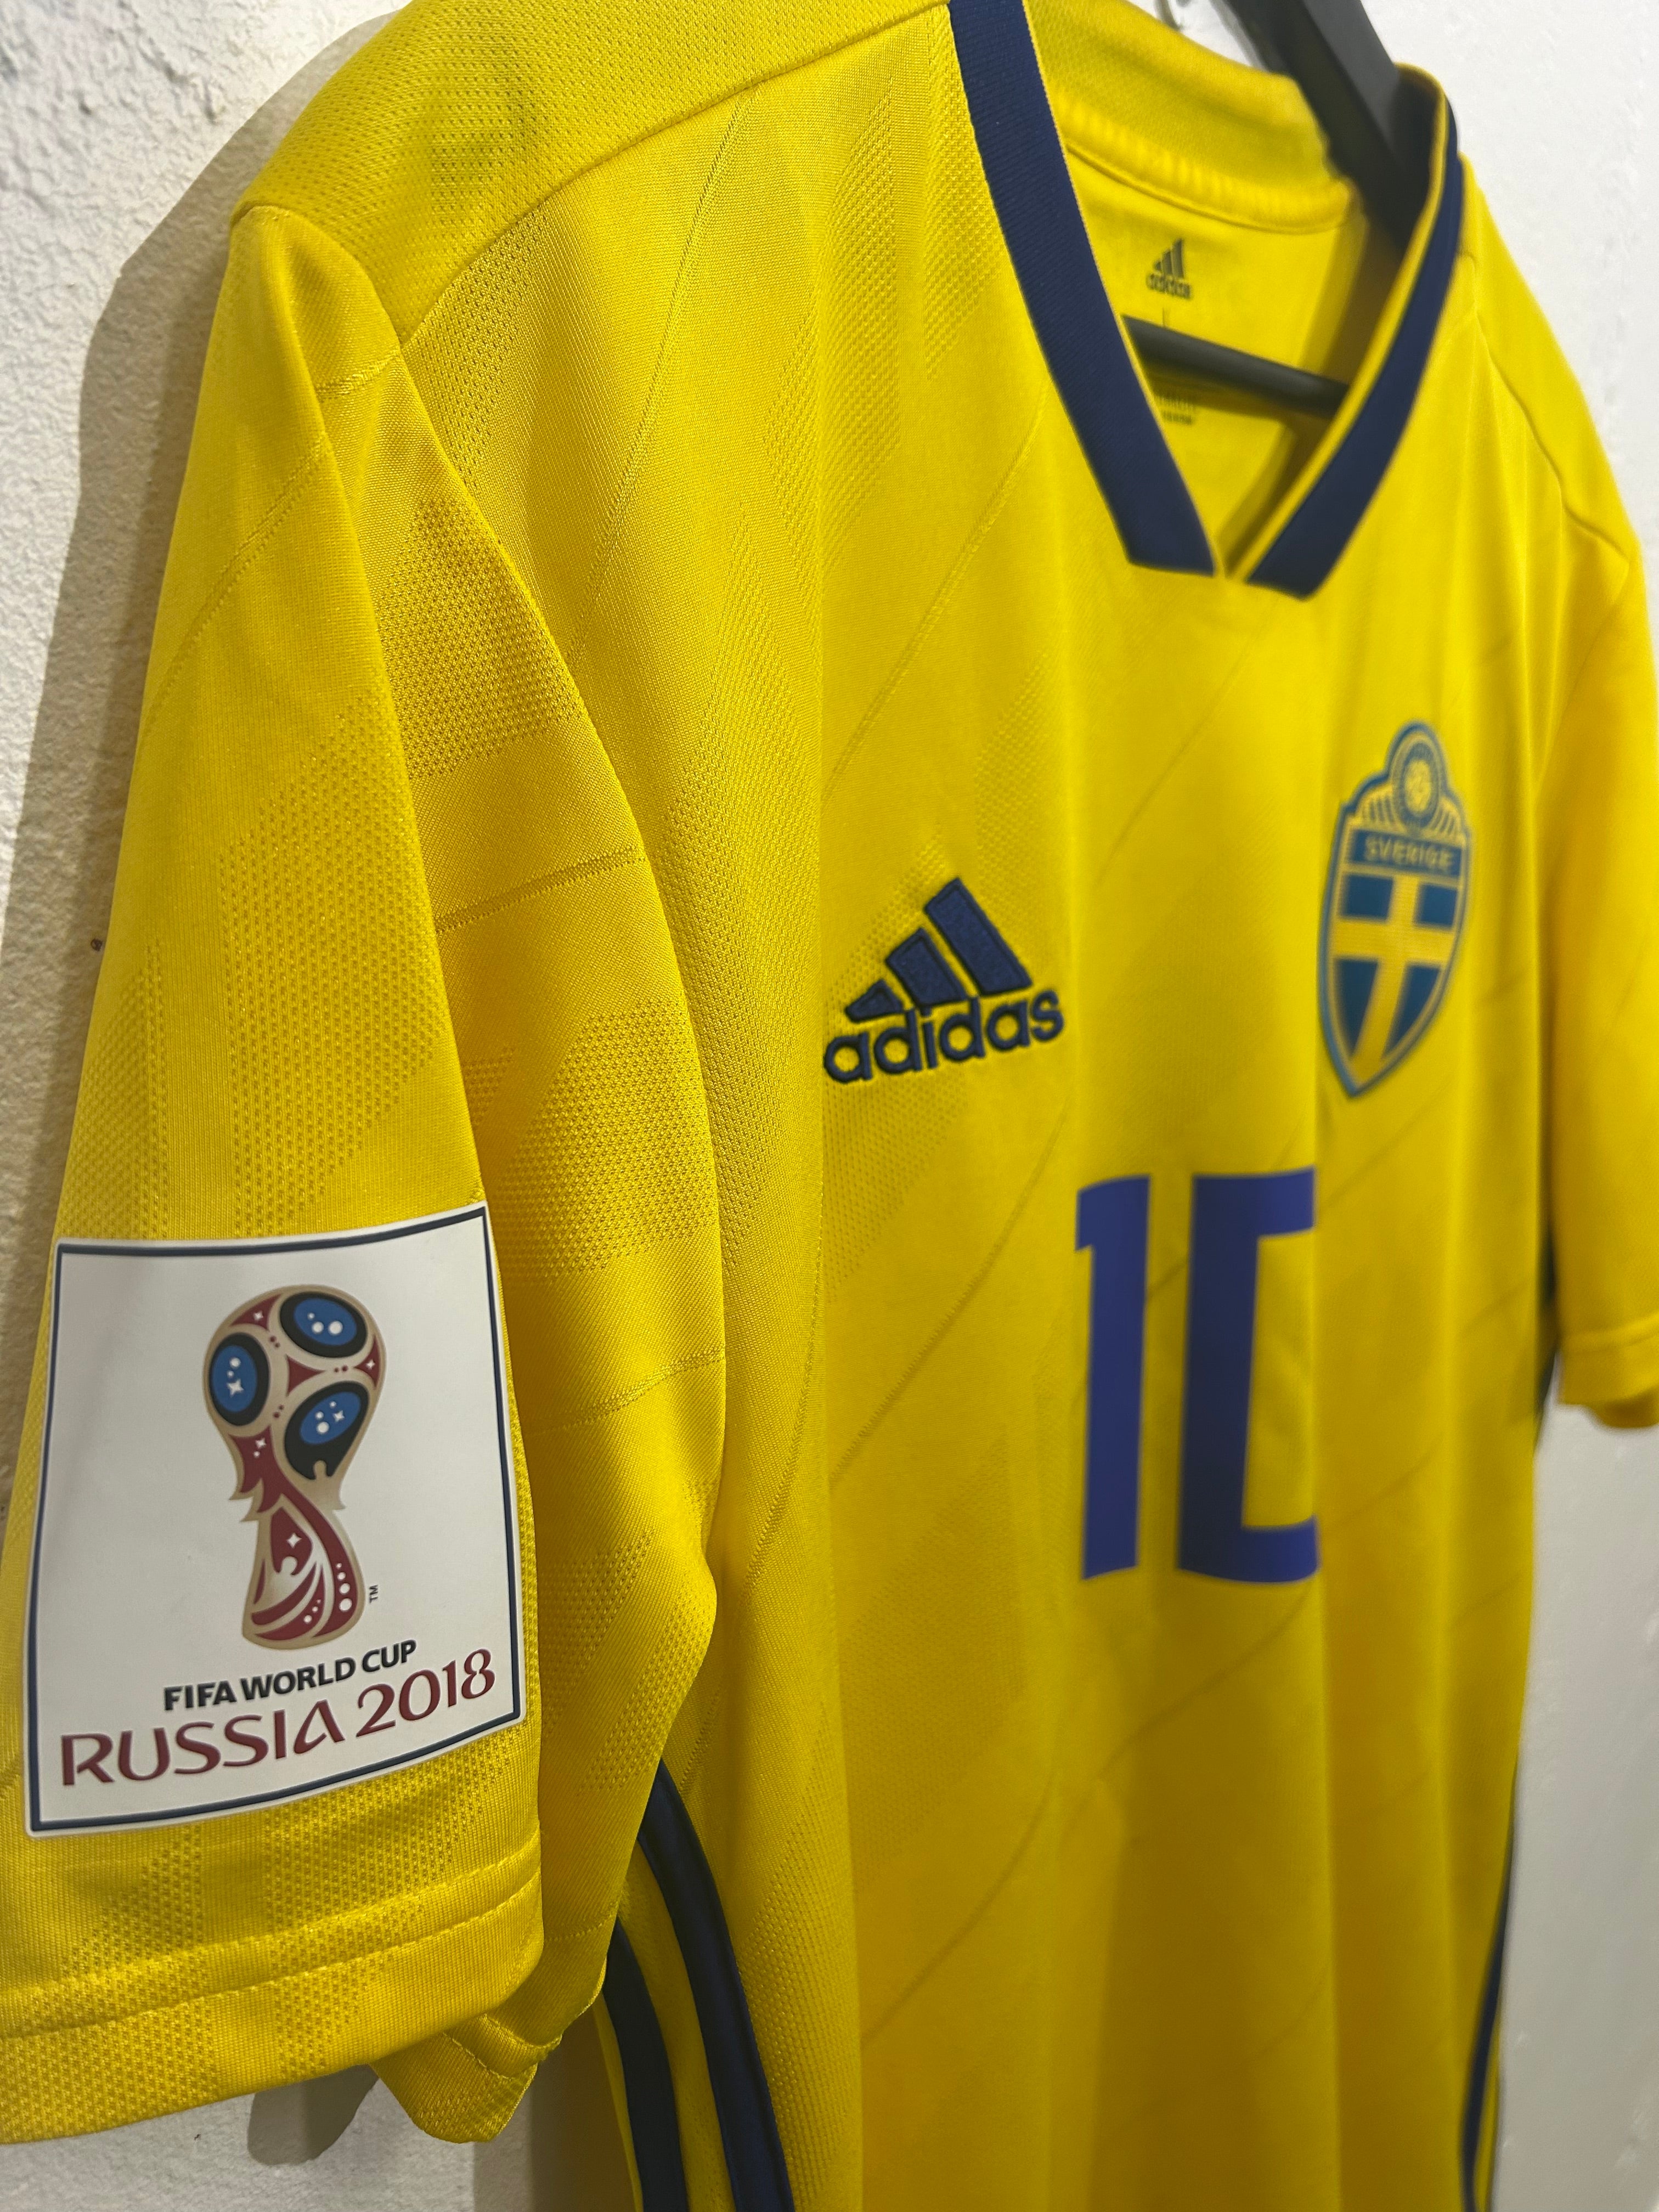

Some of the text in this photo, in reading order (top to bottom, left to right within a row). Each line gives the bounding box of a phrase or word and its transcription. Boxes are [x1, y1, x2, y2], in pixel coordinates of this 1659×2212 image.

[1364, 834, 1453, 871] SVERIGE
[823, 989, 1064, 1084] adidas
[369, 1584, 379, 1604] TM
[163, 1639, 417, 1712] FIFA WORLD CUP
[61, 1648, 496, 1787] RUSSIA 2018
